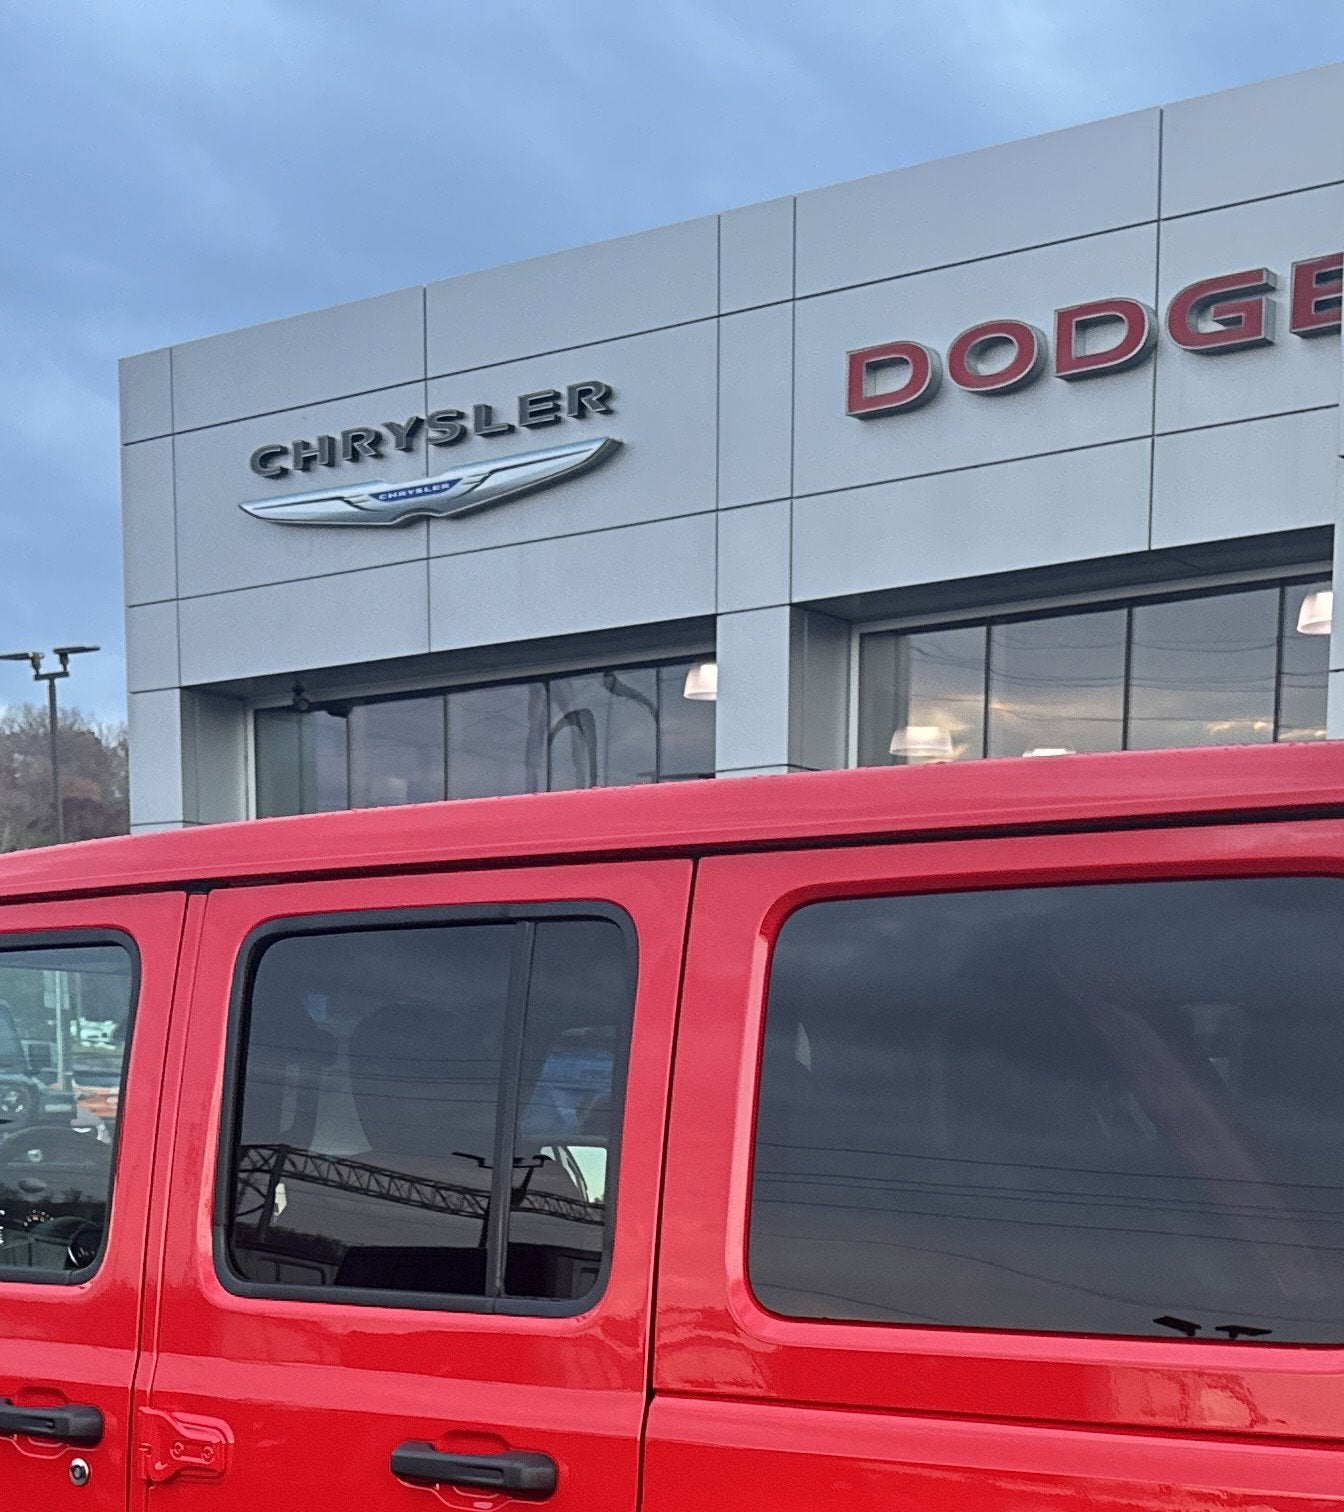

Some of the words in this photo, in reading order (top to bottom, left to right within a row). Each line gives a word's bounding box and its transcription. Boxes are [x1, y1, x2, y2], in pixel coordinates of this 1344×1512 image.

[845, 252, 1344, 420] DODGE
[249, 379, 614, 478] CHRYSLER
[378, 483, 450, 500] CHRYSLER
